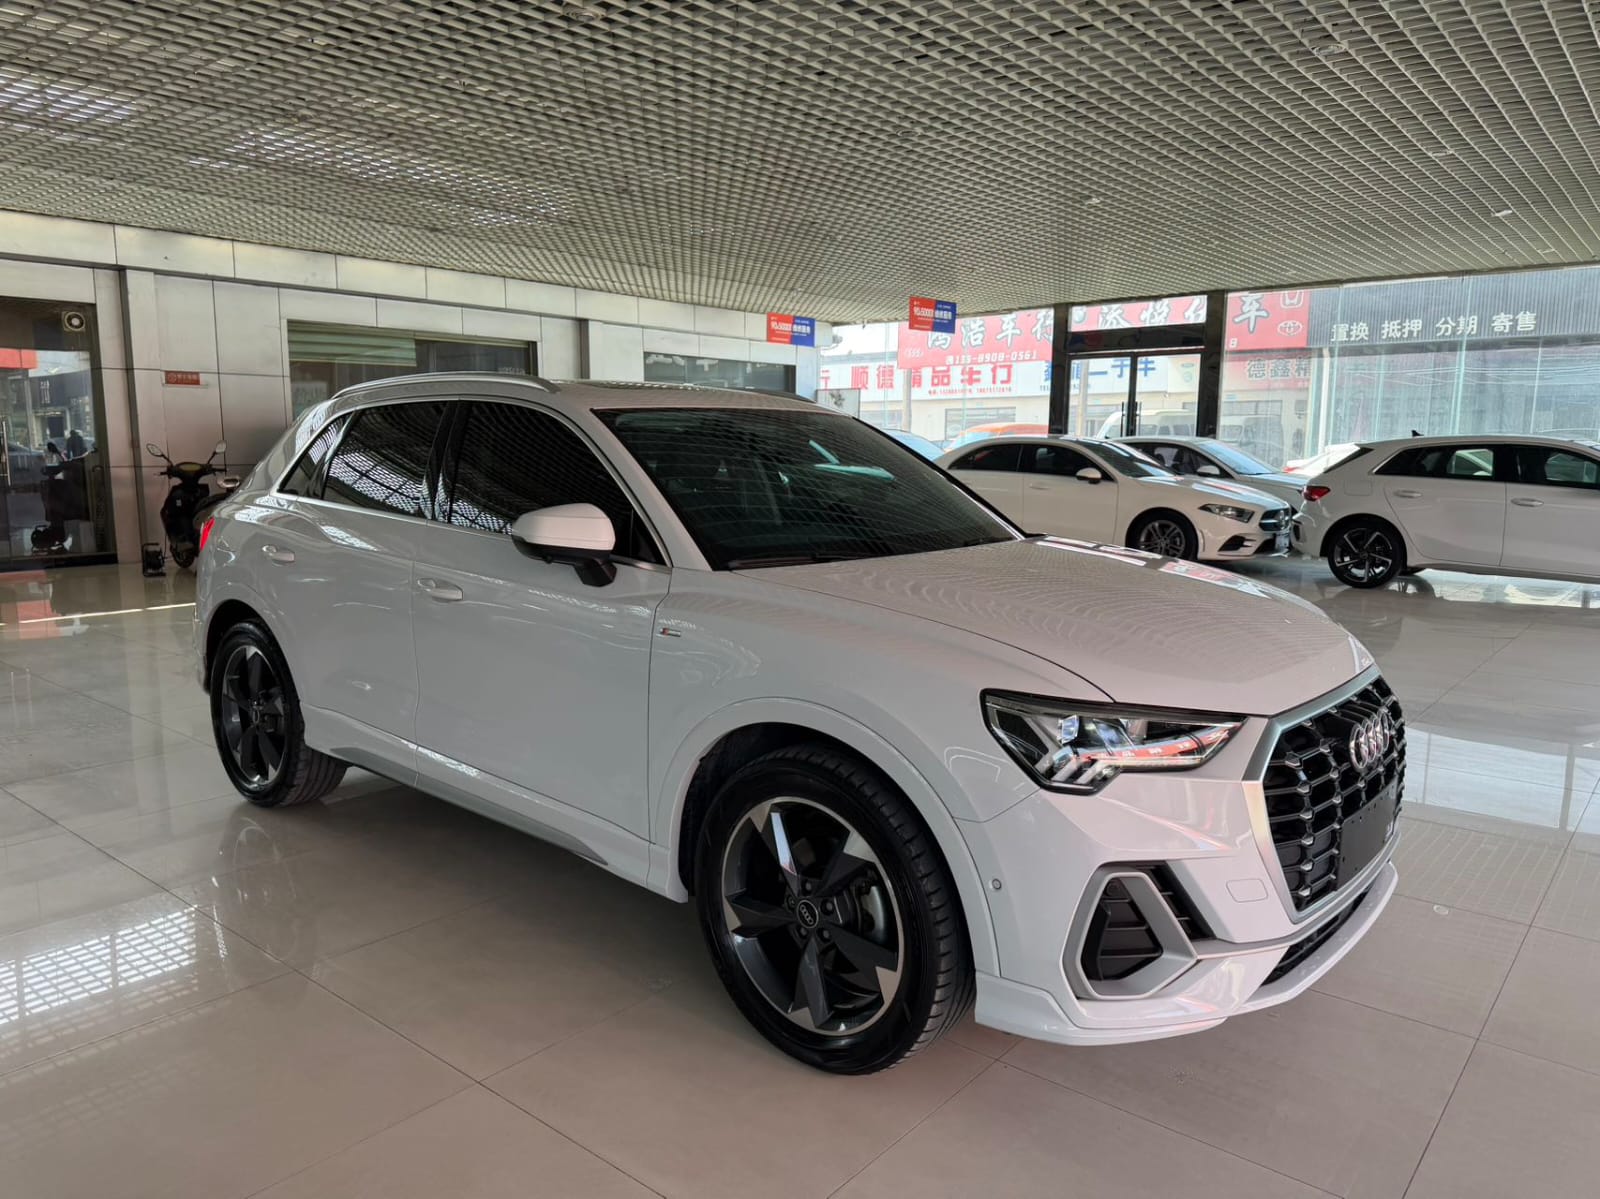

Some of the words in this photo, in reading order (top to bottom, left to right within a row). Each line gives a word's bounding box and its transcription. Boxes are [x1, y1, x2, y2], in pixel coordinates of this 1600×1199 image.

[1331, 321, 1369, 342] 置换
[1381, 318, 1423, 339] 抵押
[1435, 315, 1478, 336] 分期
[1491, 311, 1537, 333] 寄售
